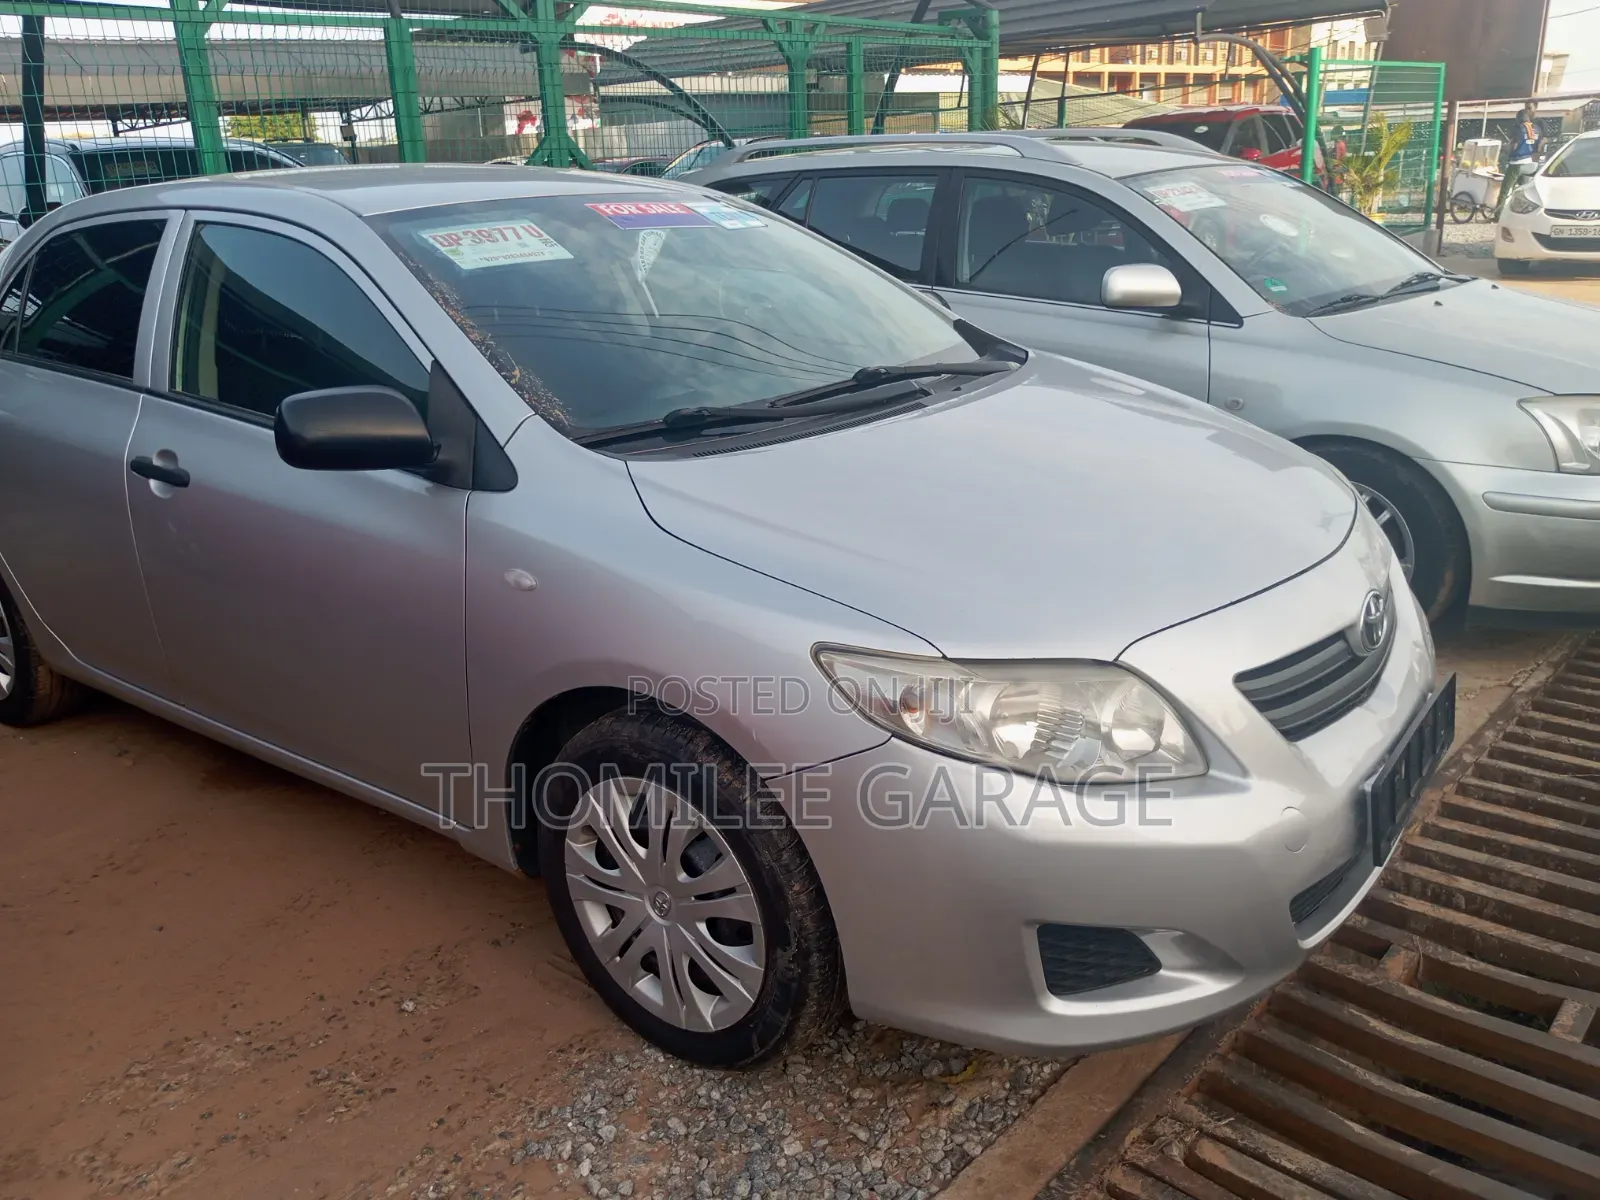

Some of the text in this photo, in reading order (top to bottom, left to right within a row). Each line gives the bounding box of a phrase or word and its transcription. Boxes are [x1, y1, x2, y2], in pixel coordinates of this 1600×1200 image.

[597, 203, 688, 215] FOR SALE
[428, 232, 464, 248] DP
[463, 226, 523, 245] 3977
